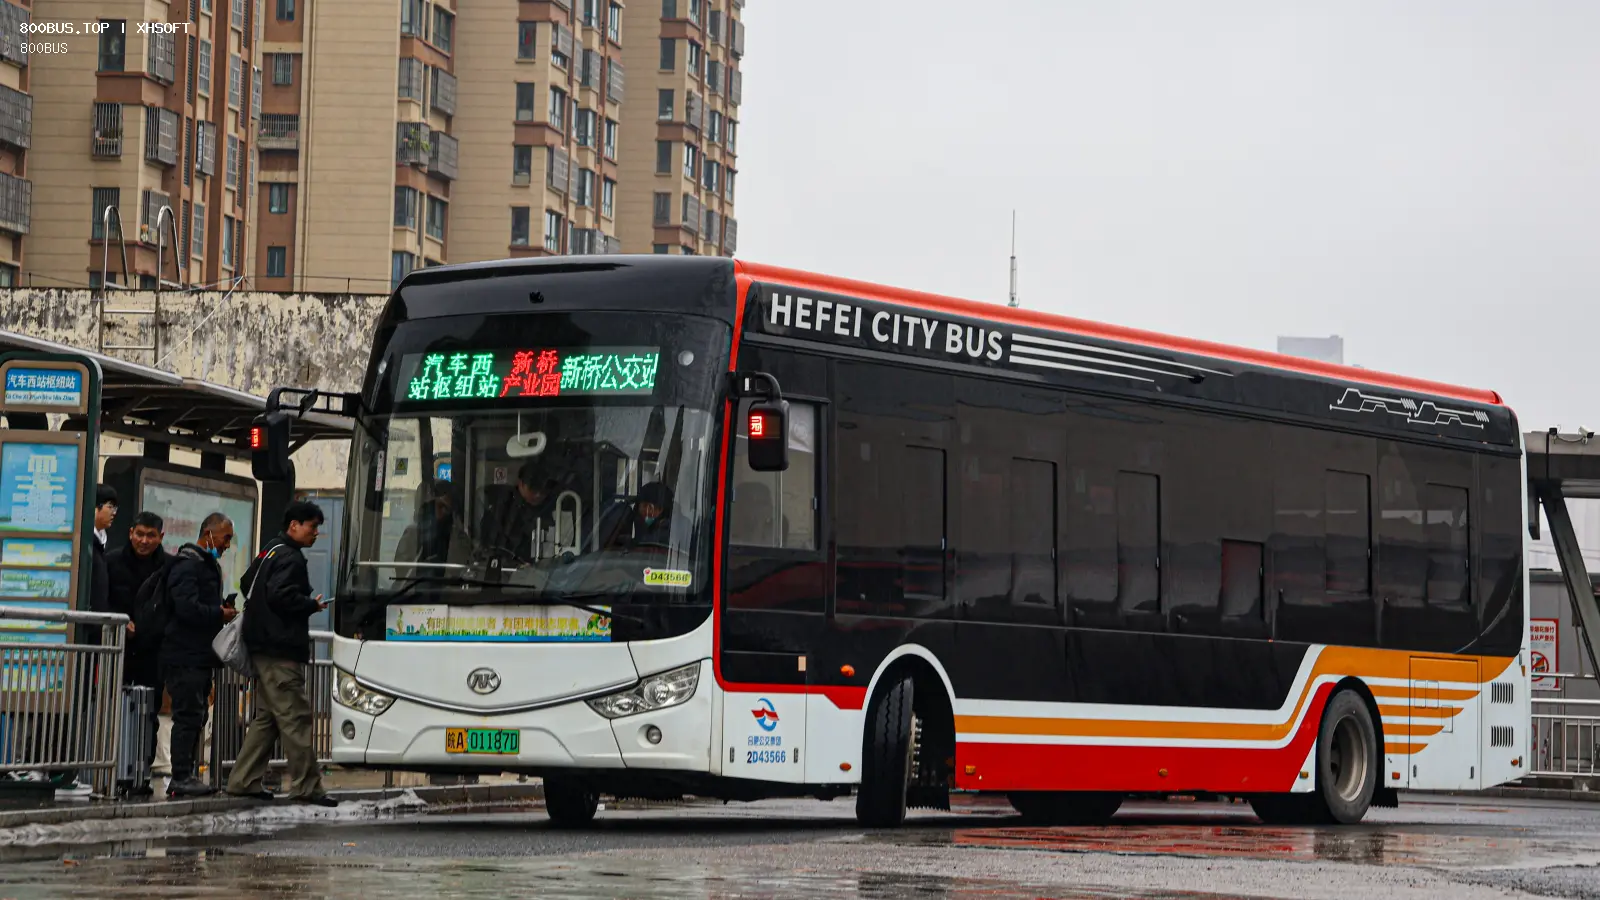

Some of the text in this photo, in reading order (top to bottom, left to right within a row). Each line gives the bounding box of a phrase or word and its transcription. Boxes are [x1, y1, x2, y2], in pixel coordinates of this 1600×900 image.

[770, 292, 1003, 361] HEFEI CITY BUS
[424, 353, 493, 378] 汽车西
[512, 350, 558, 375] 新桥
[7, 374, 76, 389] 汽车西站枢纽站
[408, 374, 499, 399] 站枢纽站
[500, 372, 562, 397] 产业园
[747, 751, 786, 763] 2D43566
